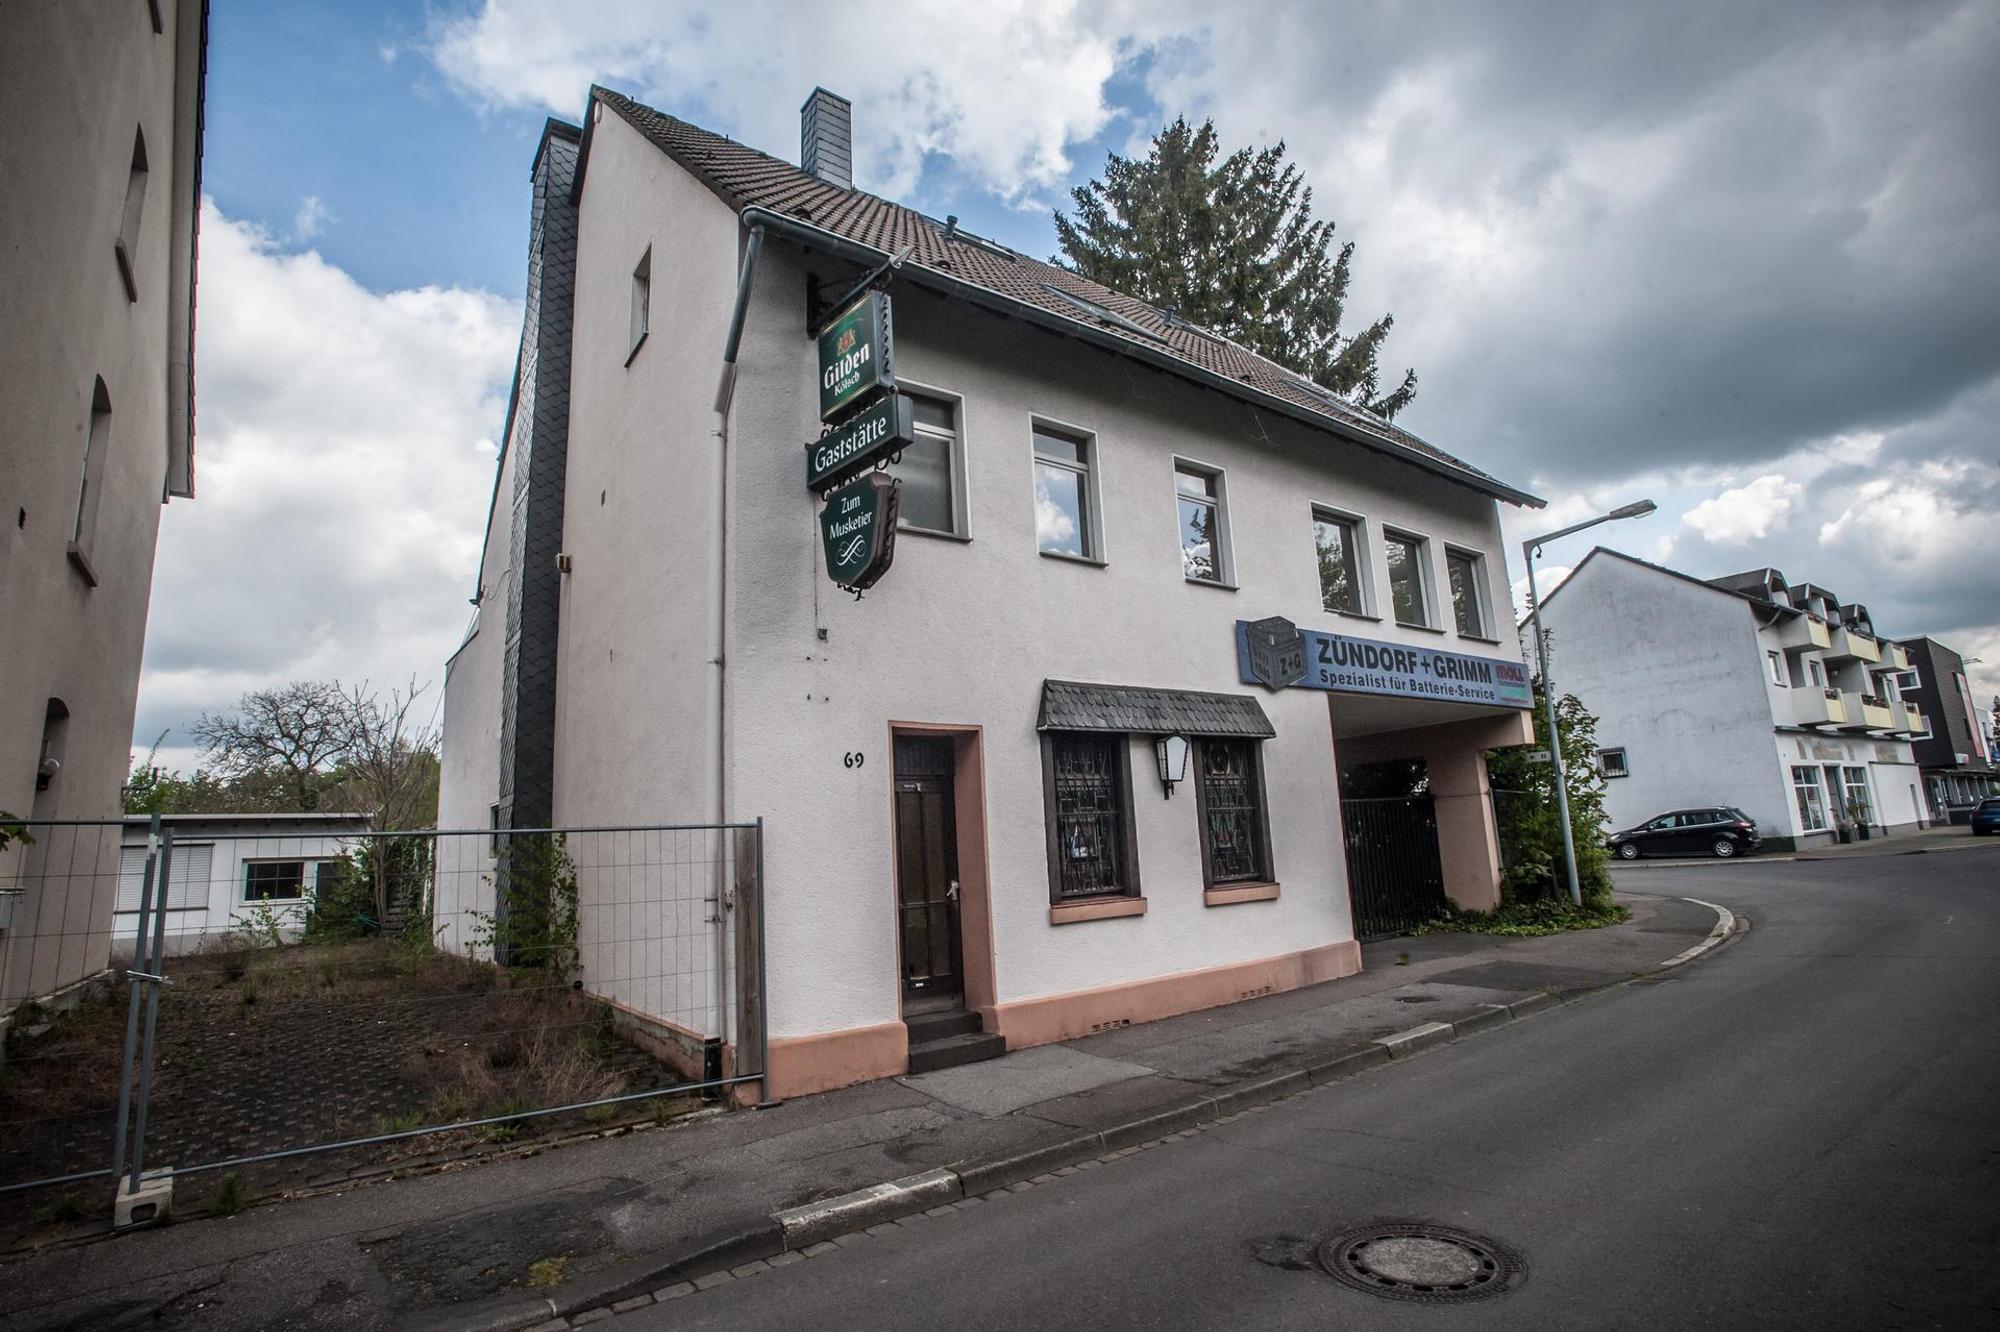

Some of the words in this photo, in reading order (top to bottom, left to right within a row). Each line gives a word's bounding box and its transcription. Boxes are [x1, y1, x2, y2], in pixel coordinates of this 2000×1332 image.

[824, 343, 869, 390] Gilden
[834, 371, 860, 396] Kölsch
[814, 416, 887, 472] Gaststätte
[841, 496, 861, 515] Zum
[829, 511, 873, 540] Musketier
[1320, 668, 1387, 690] Spezialist
[1389, 676, 1406, 691] für
[1409, 678, 1495, 701] Batterie-Service
[844, 751, 864, 769] 69
